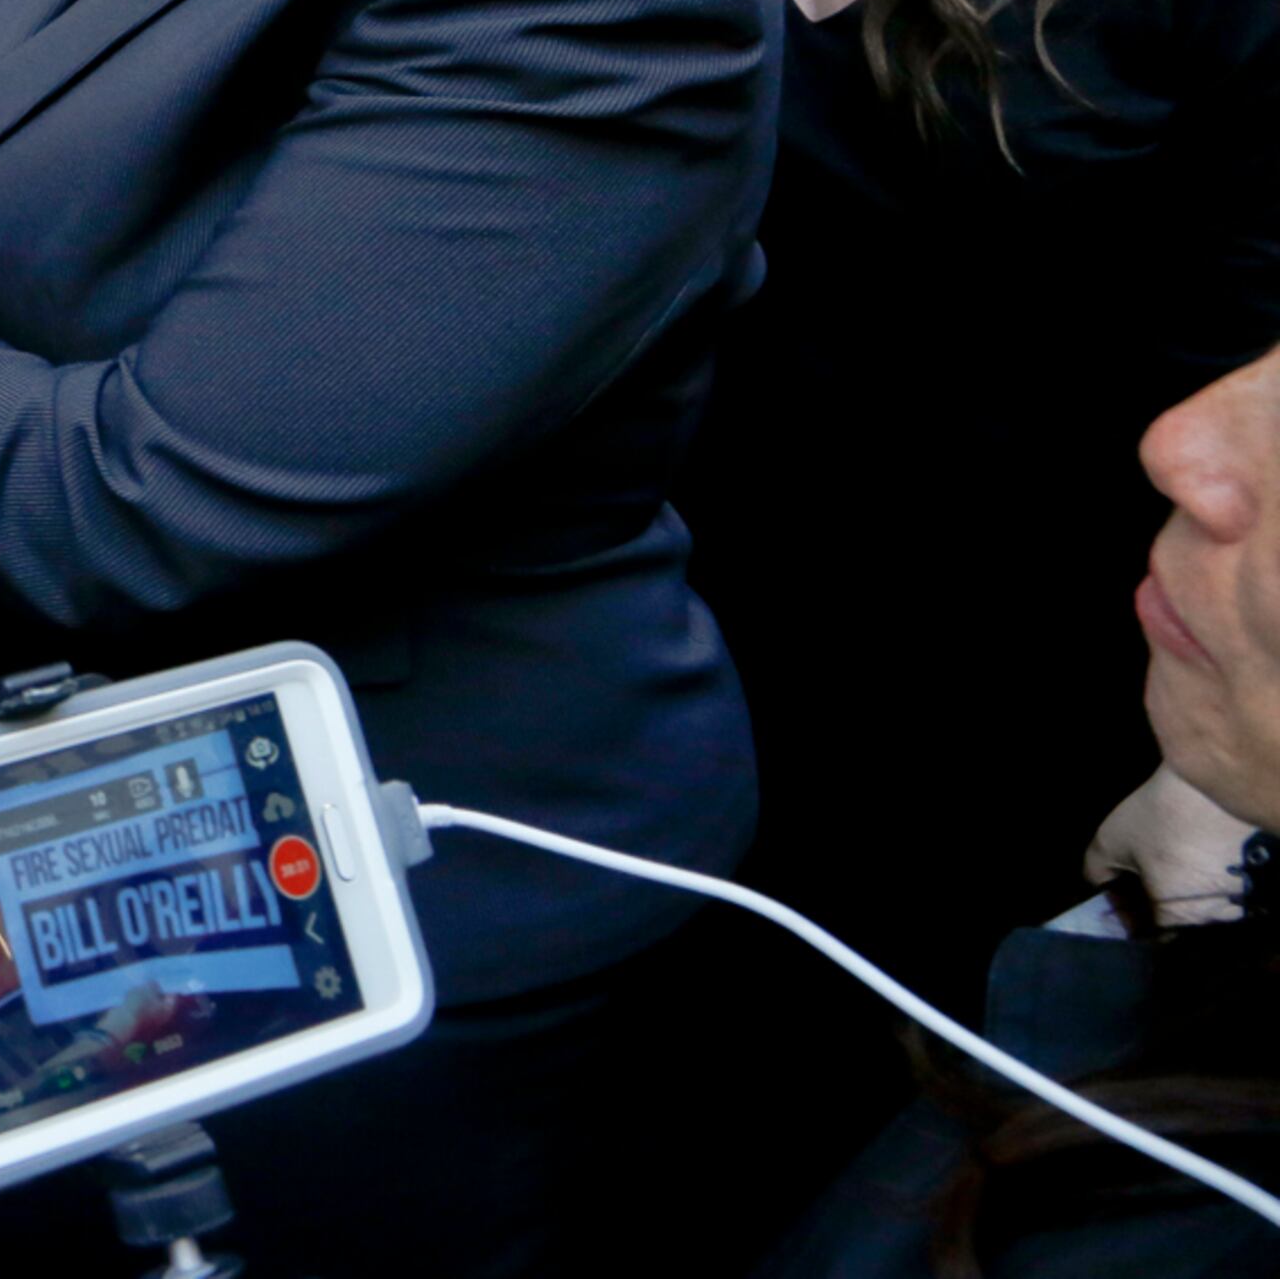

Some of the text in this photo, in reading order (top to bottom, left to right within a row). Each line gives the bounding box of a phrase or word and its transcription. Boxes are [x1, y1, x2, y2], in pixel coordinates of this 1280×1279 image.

[9, 846, 63, 892] FIRE
[61, 824, 153, 879] SEXUAL
[29, 894, 118, 972] BILL
